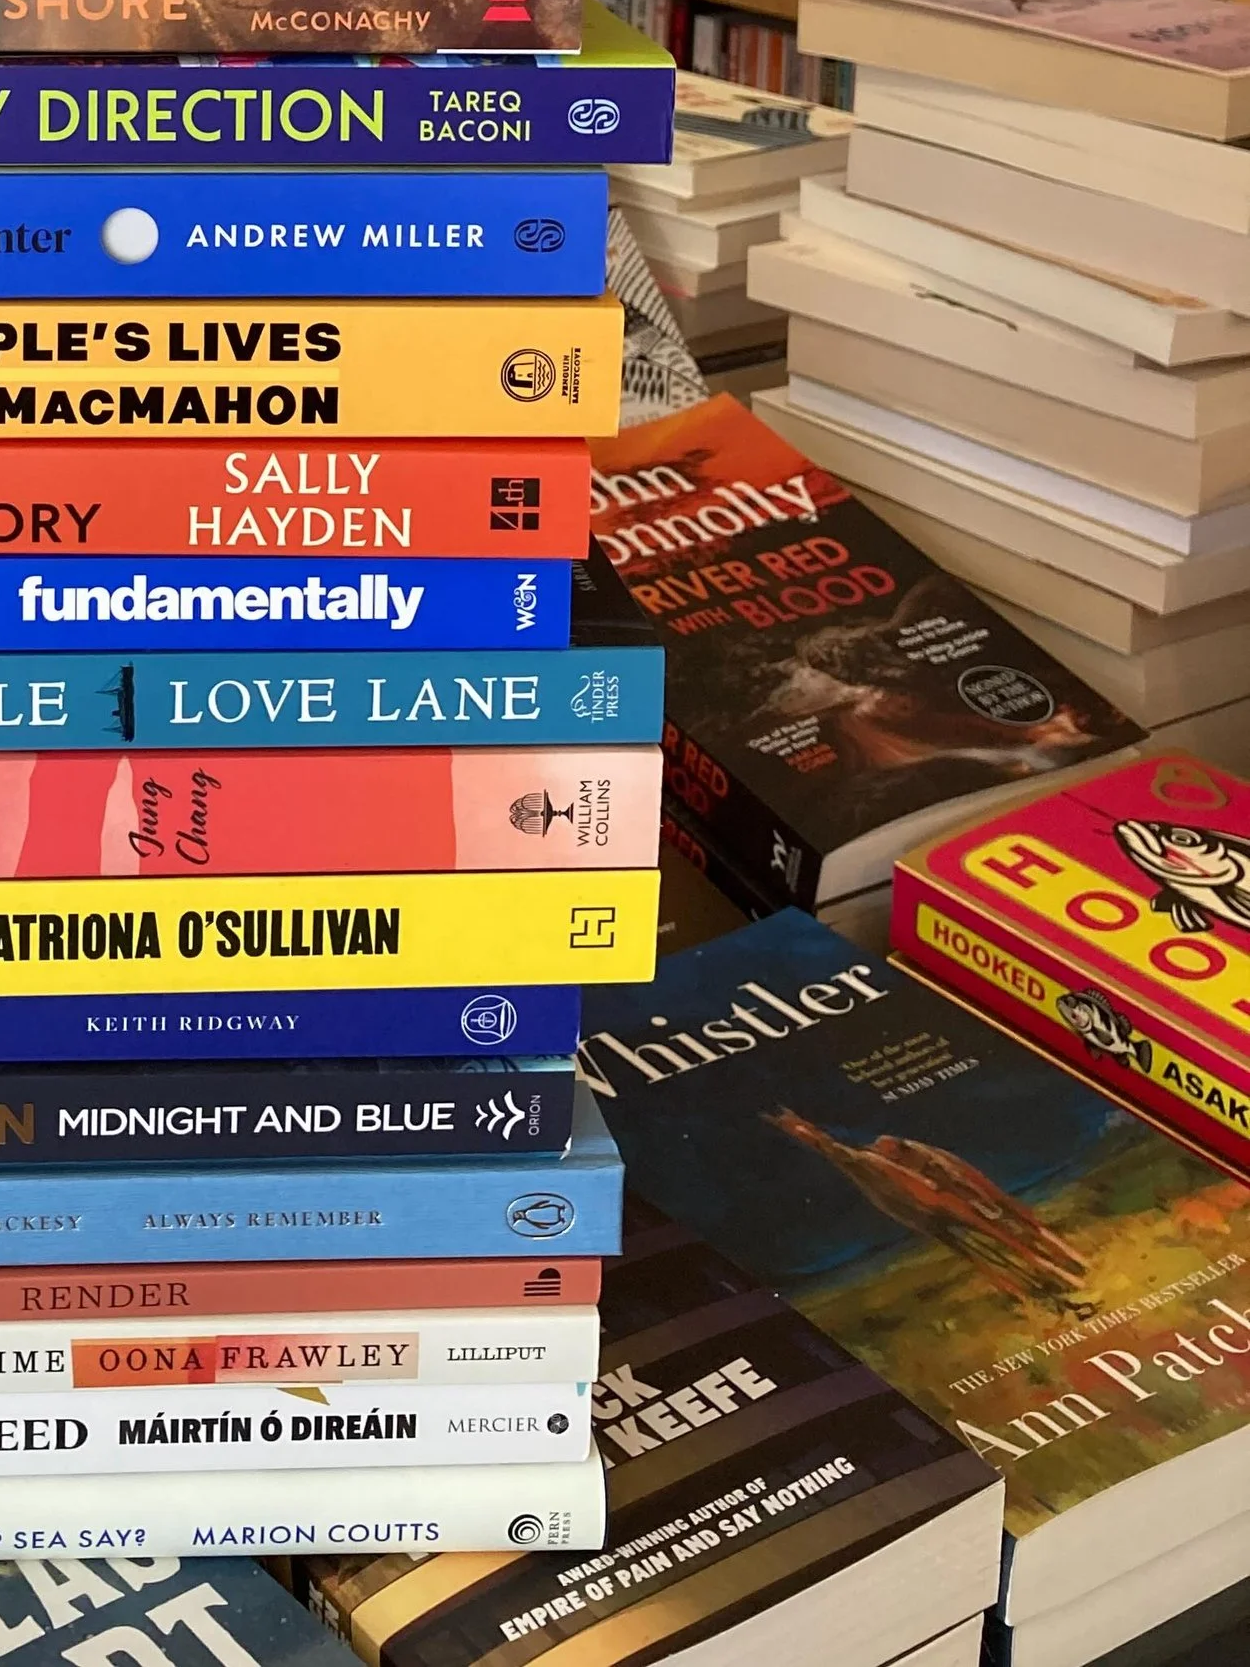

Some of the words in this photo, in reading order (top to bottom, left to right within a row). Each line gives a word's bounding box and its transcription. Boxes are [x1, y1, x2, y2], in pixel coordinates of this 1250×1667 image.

[250, 10, 430, 33] McCONAGHY
[168, 322, 341, 362] LIVES
[572, 347, 581, 404] SANDYCOVE
[589, 463, 697, 517] ohn
[595, 475, 818, 567] onnolly
[631, 560, 760, 615] RIVER
[764, 536, 850, 577] RED
[736, 564, 895, 630] BLOOD
[128, 777, 170, 860] Jung
[176, 767, 222, 866] Chang
[577, 779, 592, 848] WILLIAM
[595, 779, 611, 847] COLLINS
[178, 908, 400, 958] O'SULLIVAN
[933, 918, 1046, 1002] HOOKED
[143, 1211, 236, 1230] ALWAYS
[247, 1210, 384, 1228] REMEMBER
[949, 1370, 995, 1395] THE
[992, 1349, 1035, 1375] NEW
[1037, 1328, 1089, 1357] YORK
[1084, 1306, 1142, 1335] TIMES
[1138, 1252, 1246, 1311] BESTSELLER
[605, 1357, 777, 1458] KEEFE
[956, 1392, 1111, 1469] Ann
[14, 1531, 66, 1549] SEA
[78, 1529, 146, 1547] SAY?
[192, 1525, 314, 1546] MARION
[328, 1523, 439, 1543] COUTTS
[499, 1592, 585, 1643] EMPIRE
[585, 1575, 617, 1602] OF
[616, 1553, 672, 1587] PAIN
[663, 1526, 720, 1571] AND
[710, 1507, 763, 1540] SAY
[751, 1456, 855, 1514] NOTHING
[547, 1511, 560, 1543] FERN
[562, 1511, 570, 1543] PRESS
